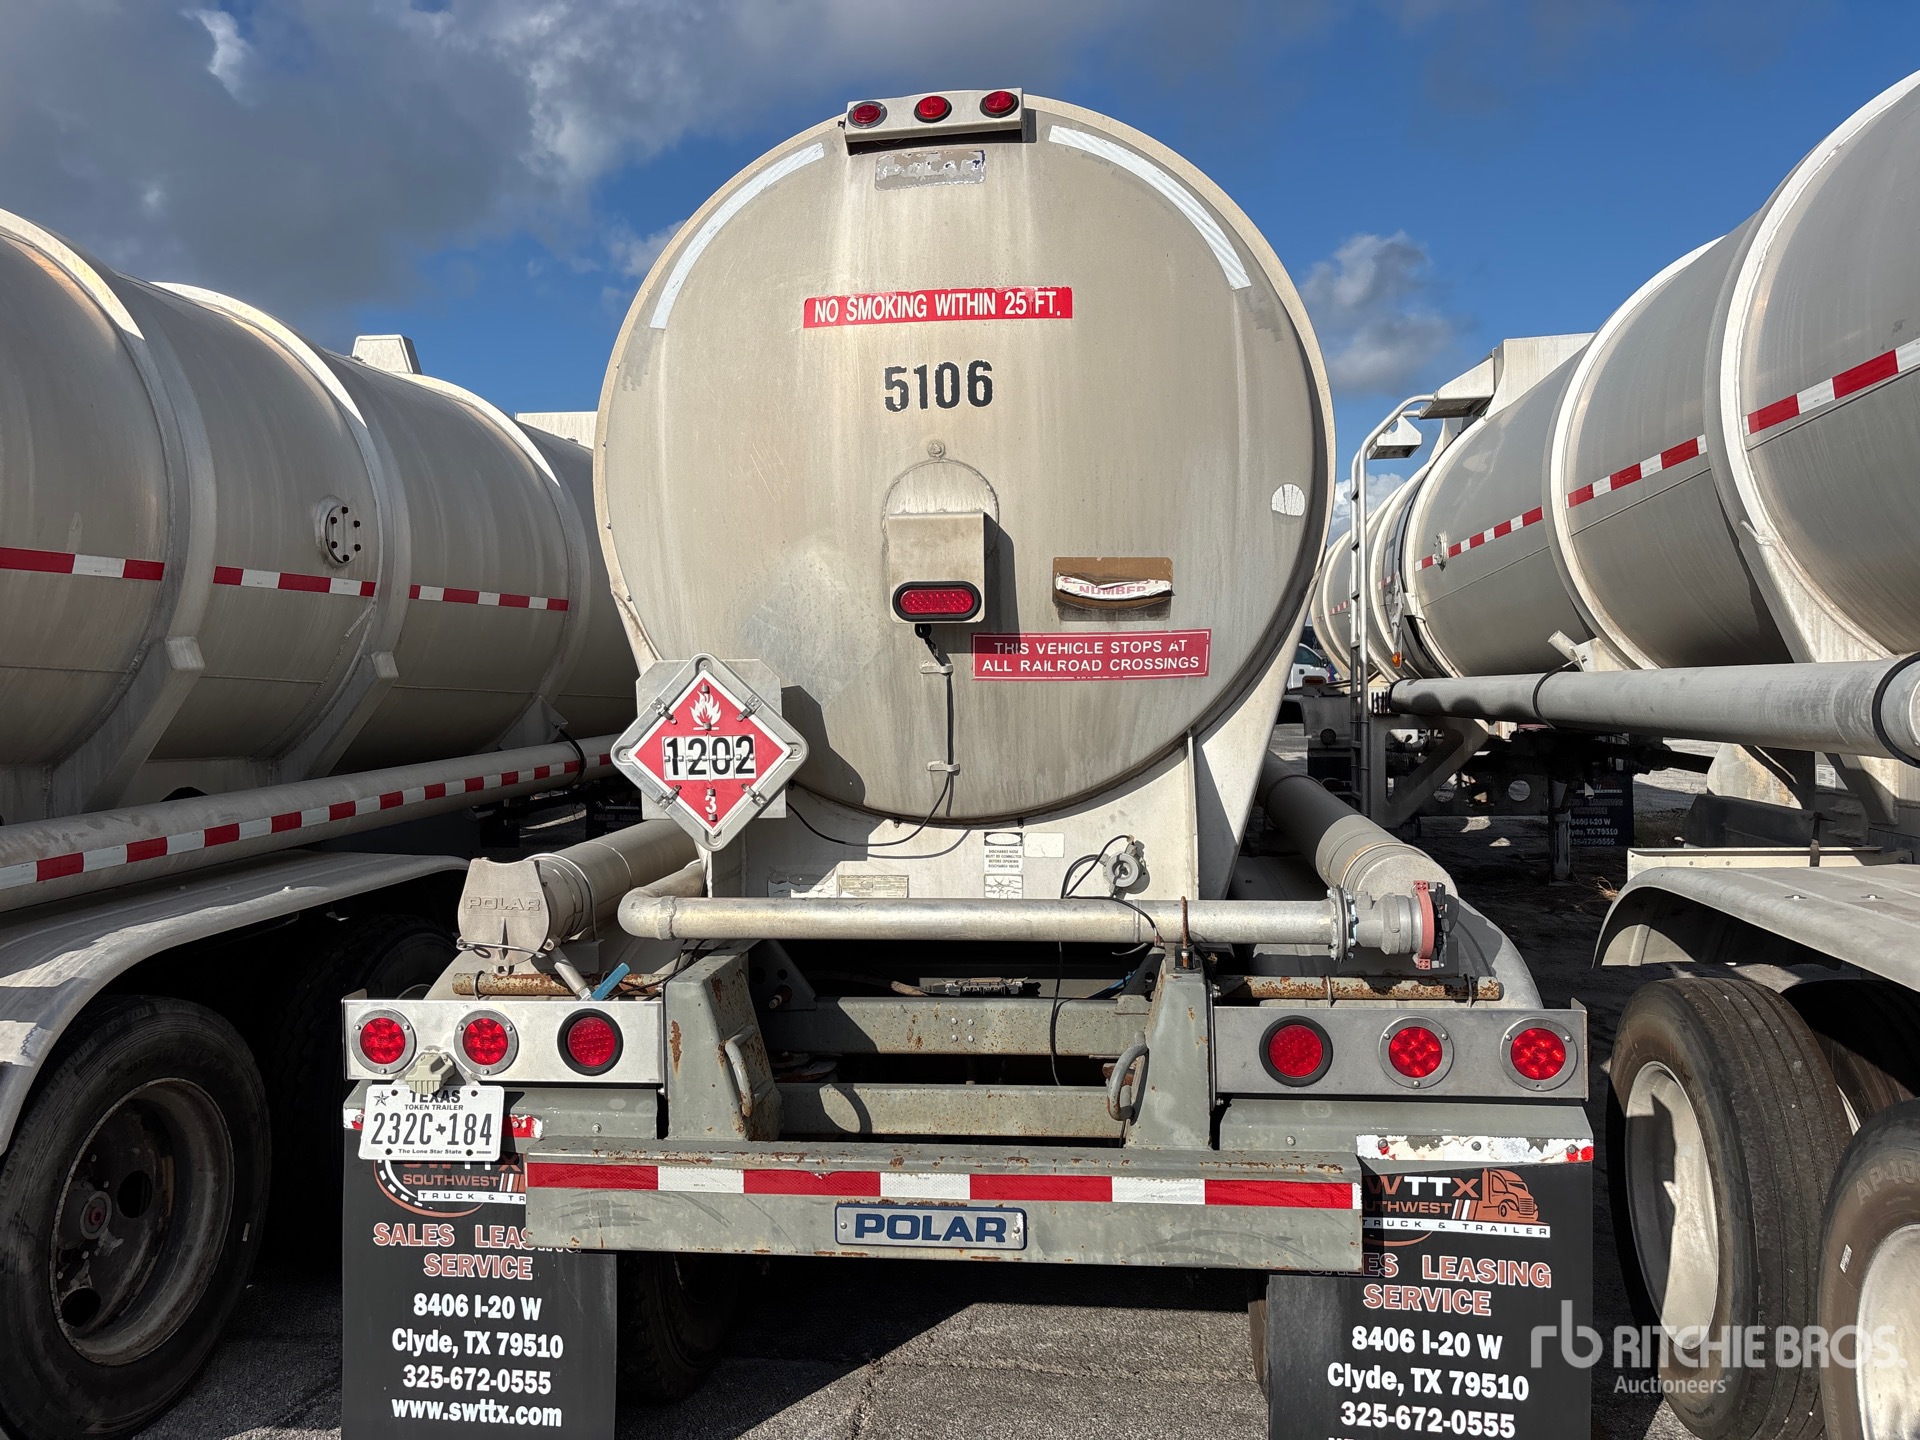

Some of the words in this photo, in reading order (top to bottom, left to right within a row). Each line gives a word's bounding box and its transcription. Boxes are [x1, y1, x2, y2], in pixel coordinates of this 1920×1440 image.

[814, 299, 838, 323] NO
[846, 295, 927, 320] SMOKING
[935, 292, 996, 317] WITHIN
[1004, 291, 1027, 315] 25
[1035, 291, 1061, 316] FT.
[884, 359, 993, 413] 5106
[994, 641, 1029, 655] THIS
[1036, 641, 1103, 655] VEHICLE
[1110, 640, 1162, 654] STOPS
[1168, 639, 1188, 652] AT
[982, 660, 1012, 672] ALL
[1019, 658, 1102, 672] RAILROAD
[1109, 656, 1199, 671] CROSSINGS
[666, 735, 755, 776] 1202
[704, 795, 717, 814] 3
[466, 896, 541, 912] POLAR
[409, 1089, 461, 1104] TEXAS
[371, 1112, 434, 1146] 232C
[446, 1112, 493, 1147] 184
[402, 1173, 500, 1187] SOUTHWEST
[1362, 1174, 1480, 1198] WTTX
[420, 1191, 475, 1200] TRUCK
[488, 1193, 495, 1201] &
[1362, 1199, 1453, 1215] UTHWEST
[373, 1222, 455, 1247] SALES
[854, 1213, 1007, 1243] POLAR
[1438, 1221, 1446, 1230] &
[1462, 1222, 1548, 1236] TRAILER
[423, 1253, 533, 1281] SERVICE
[1422, 1255, 1551, 1288] LEASING
[413, 1292, 469, 1318] 8406
[474, 1294, 515, 1319] I-20
[520, 1296, 542, 1321] W
[1363, 1284, 1492, 1316] SERVICE
[391, 1328, 459, 1359] Clyde,
[463, 1330, 491, 1355] TX
[496, 1331, 563, 1359] 79510
[1351, 1325, 1415, 1353] 8406
[1422, 1329, 1470, 1358] I-20
[1477, 1333, 1503, 1360] W
[402, 1364, 551, 1395] 325-672-0555
[1327, 1362, 1404, 1397] Clyde,
[1411, 1367, 1443, 1395] TX
[1448, 1370, 1529, 1401] 79510
[391, 1398, 562, 1427] www.swttx.com
[1340, 1401, 1516, 1440] 325-672-0555
